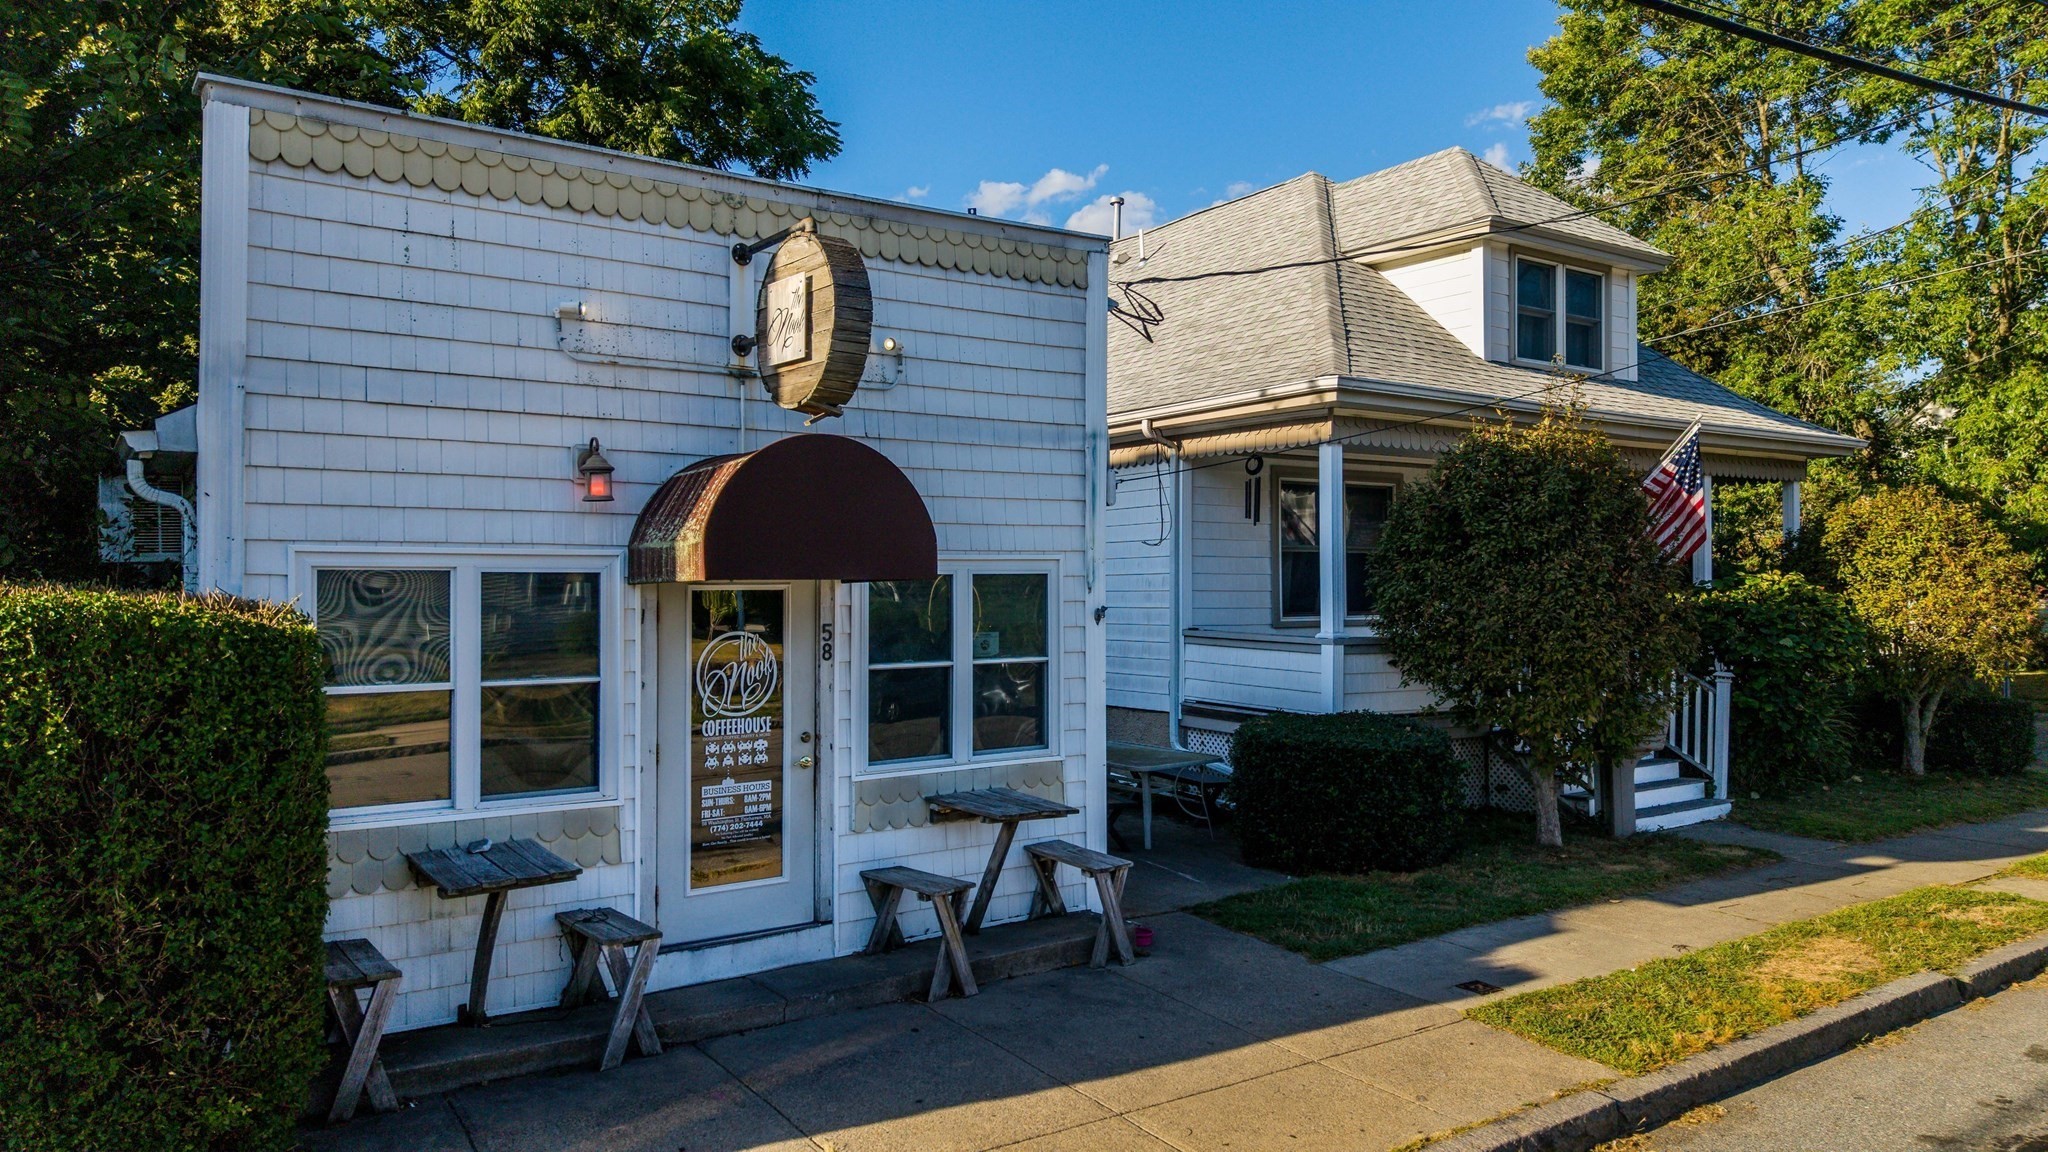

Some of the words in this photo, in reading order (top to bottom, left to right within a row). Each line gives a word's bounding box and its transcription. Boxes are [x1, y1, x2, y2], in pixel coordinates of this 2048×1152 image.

[767, 307, 804, 354] Nook
[822, 623, 832, 661] 58
[702, 646, 776, 717] Nook
[702, 716, 772, 737] COFFEEHOUSE
[704, 786, 741, 796] BUSINESS
[743, 783, 770, 792] HOURS
[702, 797, 735, 808] SUN-THURS:
[702, 809, 725, 818] FRI-SAT:
[710, 824, 729, 834] (774)
[730, 820, 763, 830] 202-7444
